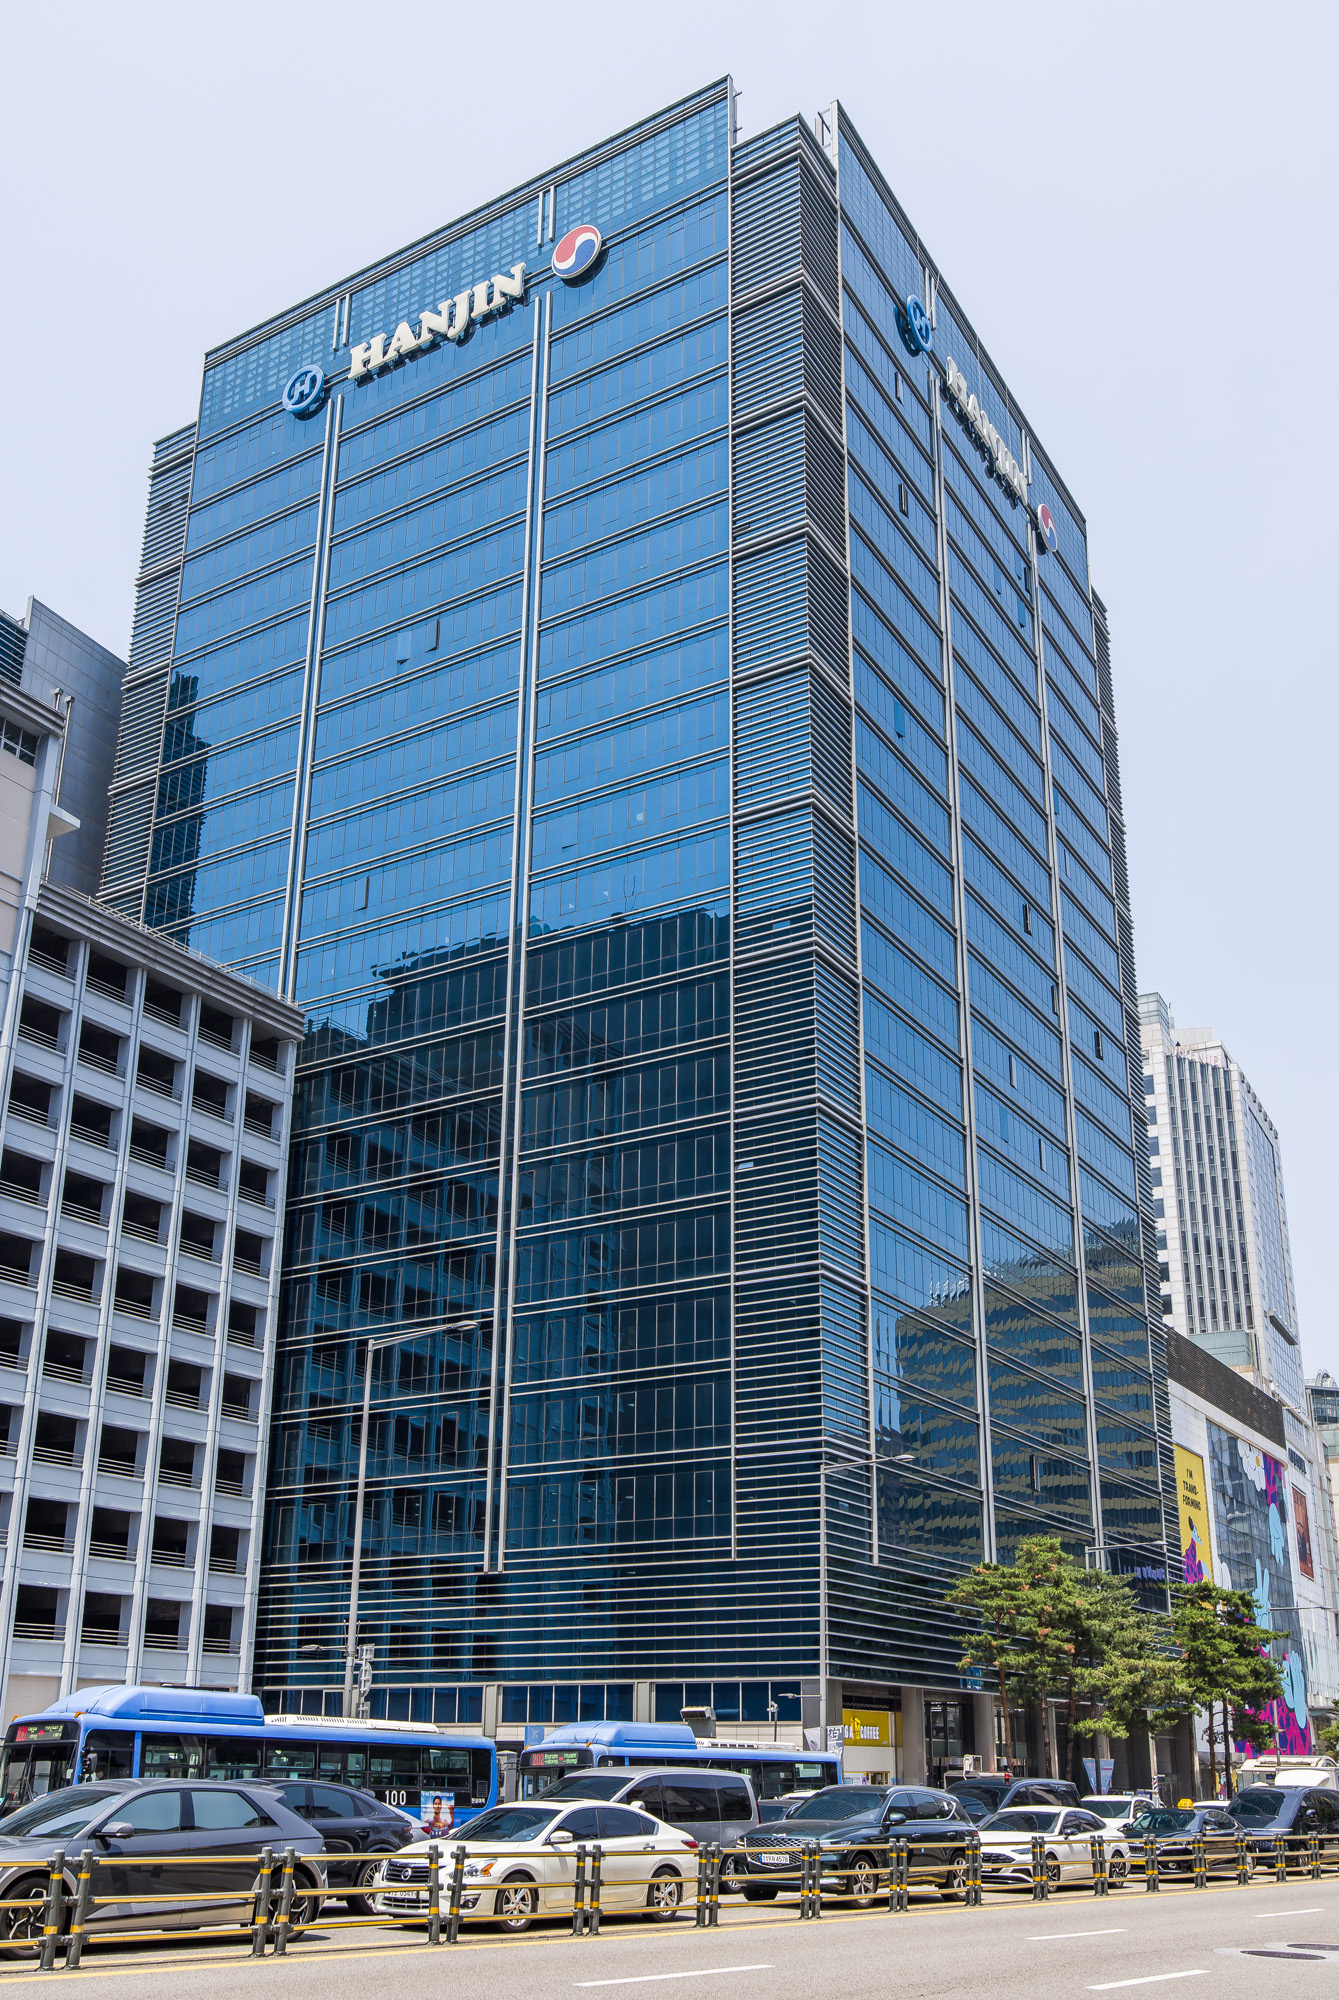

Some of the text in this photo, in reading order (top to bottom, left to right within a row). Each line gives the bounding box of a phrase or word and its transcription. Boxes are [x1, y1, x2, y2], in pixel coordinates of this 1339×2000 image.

[348, 261, 527, 380] HANJIN
[860, 1726, 880, 1740] COFFEE
[532, 1754, 544, 1765] 202
[385, 1790, 406, 1805] 100
